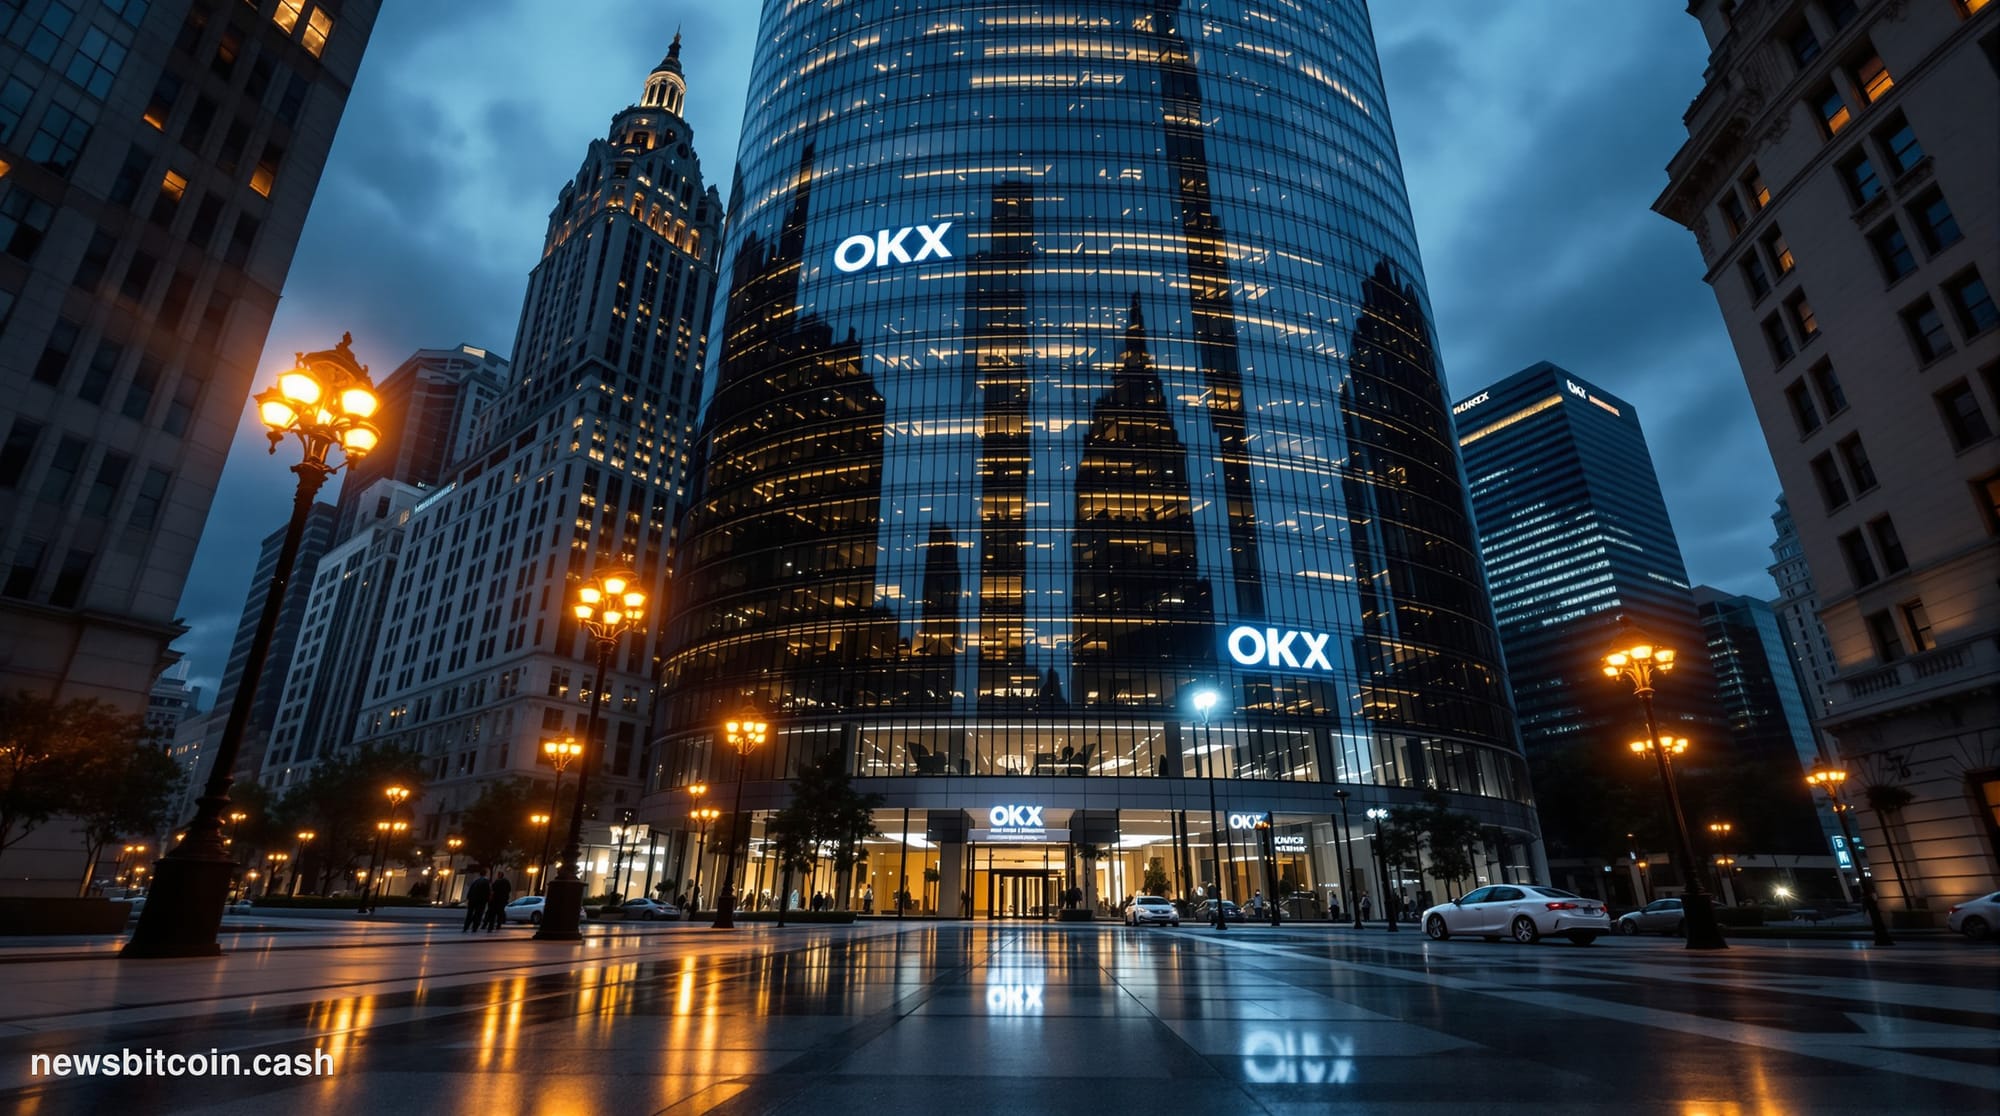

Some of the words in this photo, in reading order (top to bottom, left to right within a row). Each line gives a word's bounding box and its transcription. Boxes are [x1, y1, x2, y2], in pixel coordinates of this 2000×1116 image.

[834, 222, 953, 273] OKX
[1228, 625, 1333, 671] OKX
[989, 804, 1044, 827] OKX
